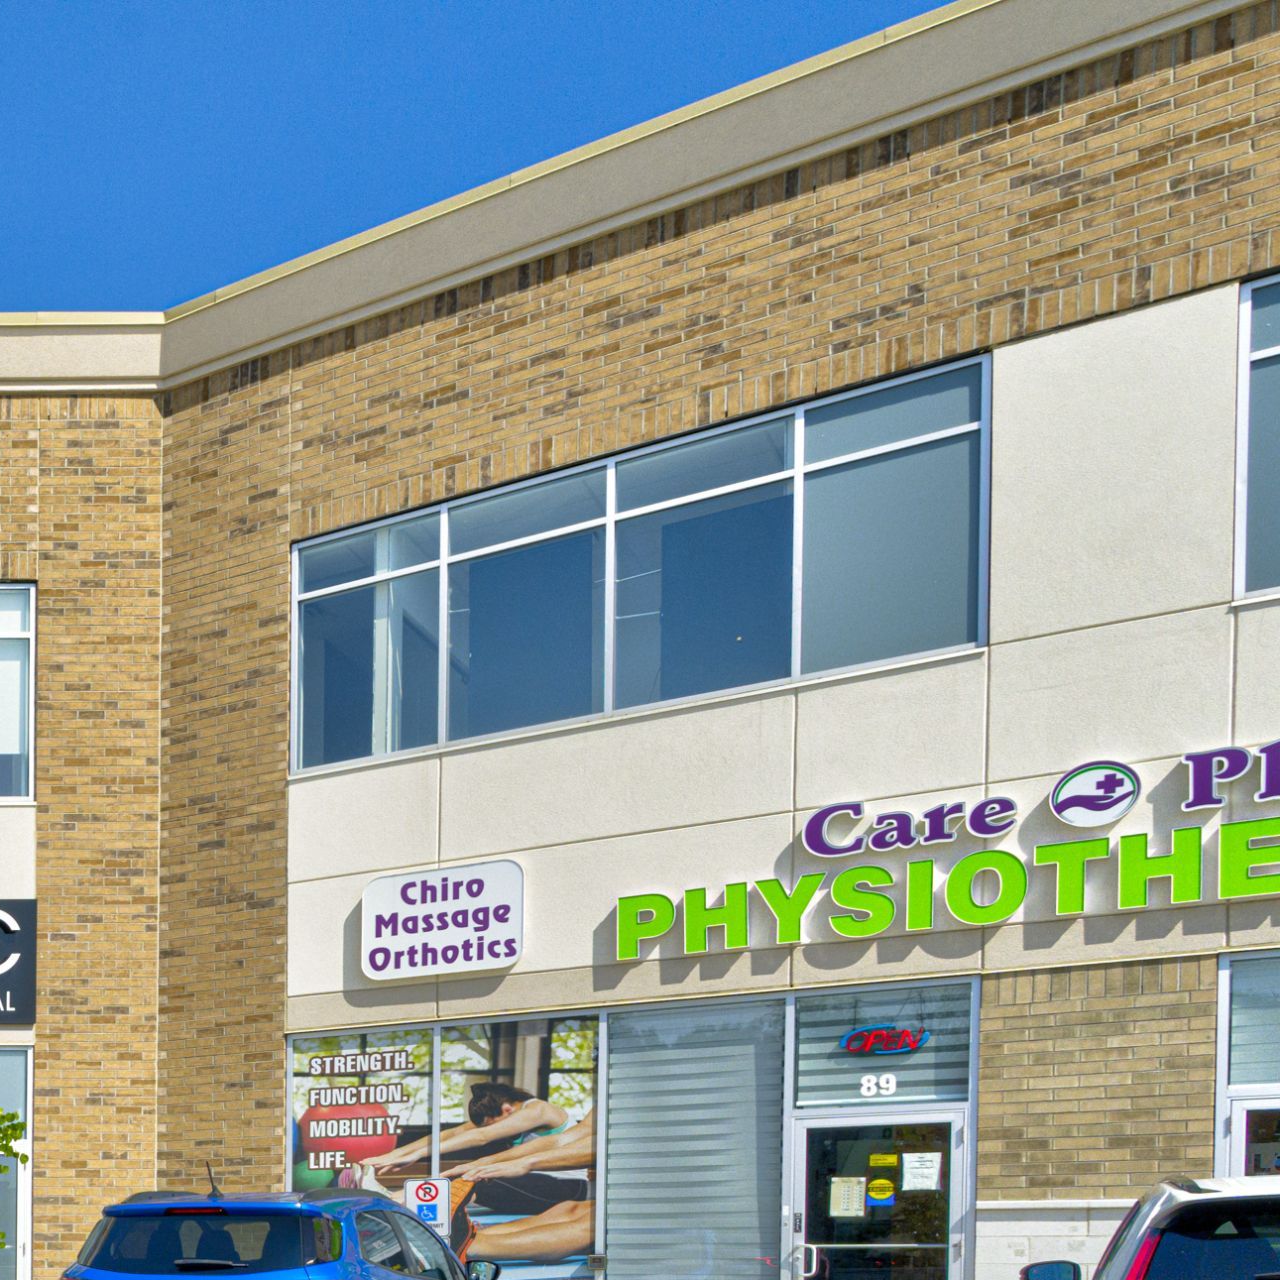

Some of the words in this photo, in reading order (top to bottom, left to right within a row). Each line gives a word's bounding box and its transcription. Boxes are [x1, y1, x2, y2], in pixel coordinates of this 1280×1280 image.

[802, 796, 1017, 857] Care
[400, 877, 485, 906] Chiro
[375, 904, 511, 938] Massage
[368, 936, 517, 972] Orthotics
[846, 1026, 924, 1053] OPEN
[310, 1051, 414, 1075] STRENGTH.
[309, 1083, 409, 1107] FUNCTION.
[860, 1074, 897, 1096] 89
[309, 1115, 402, 1138] MOBILITY.
[308, 1151, 351, 1169] LIFE.
